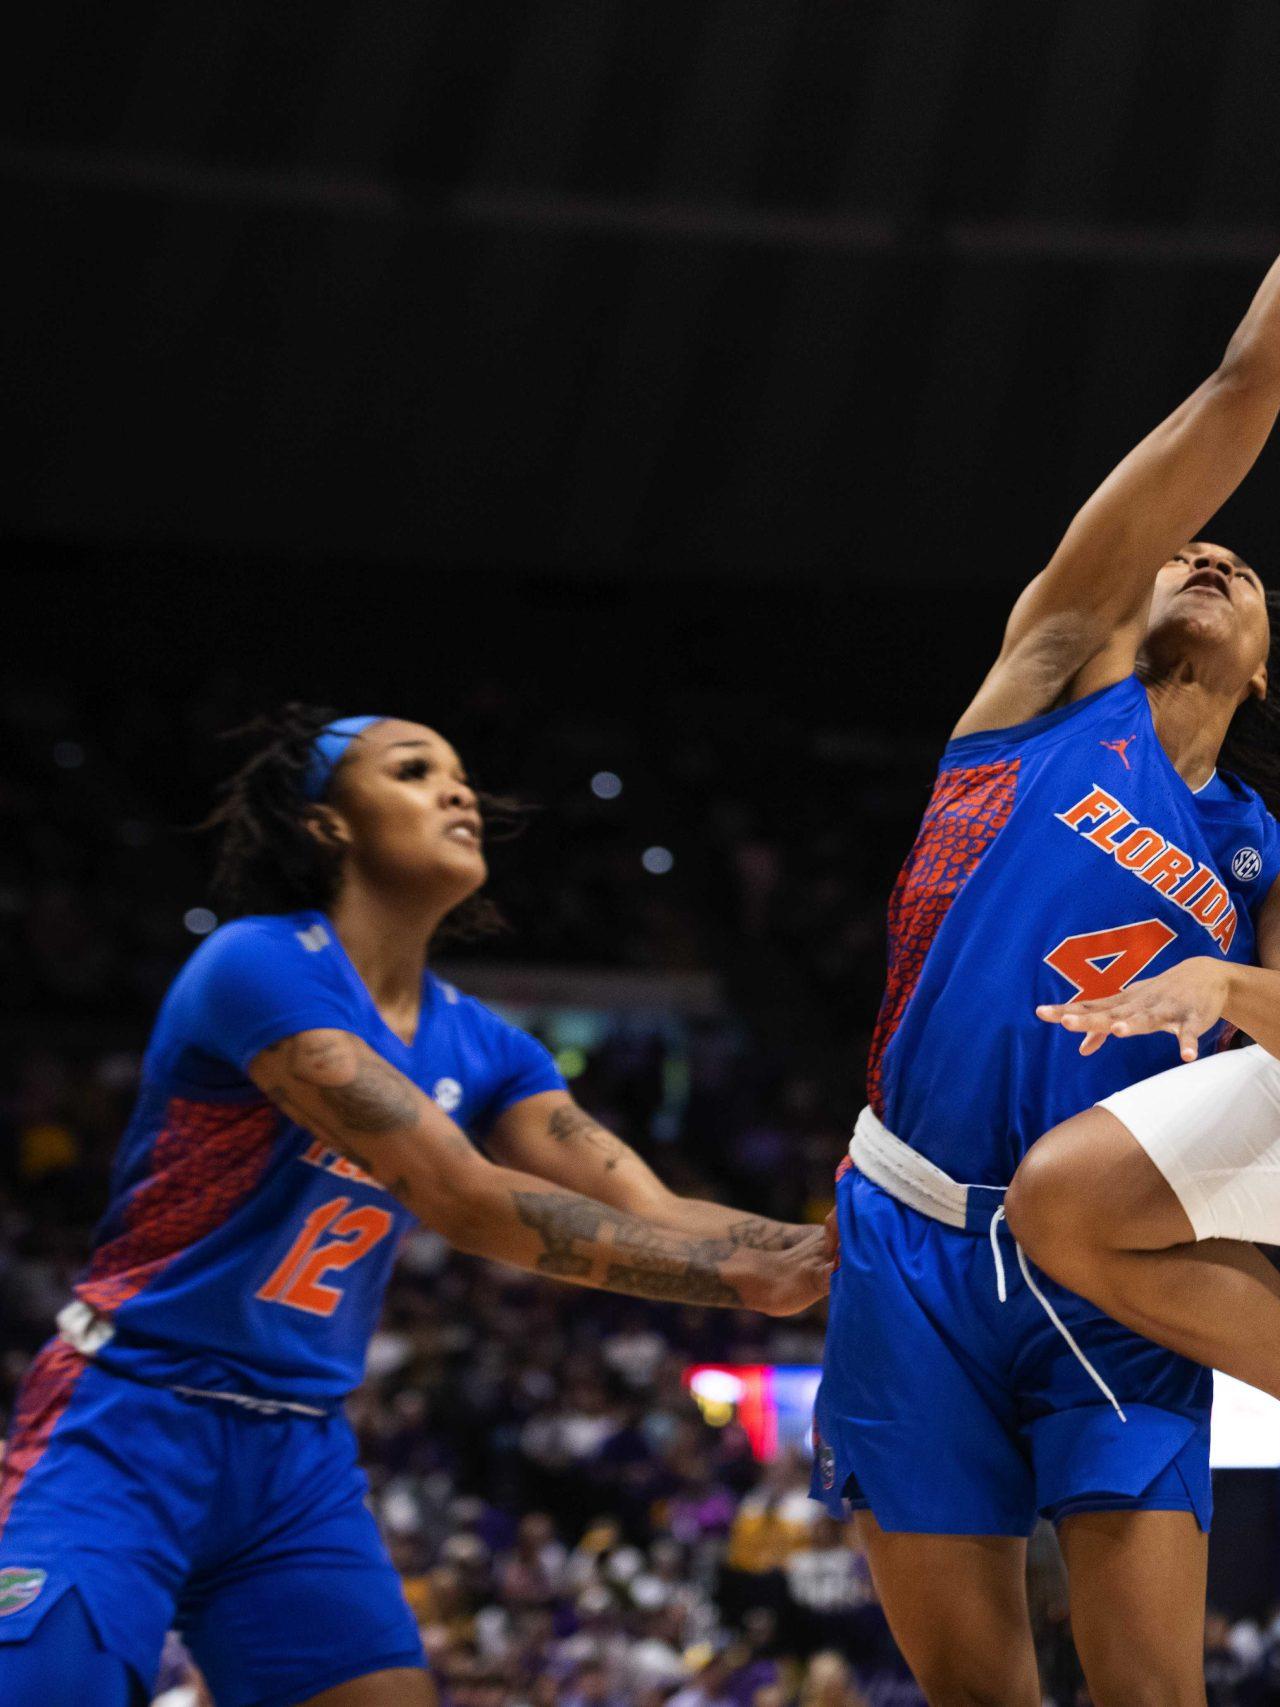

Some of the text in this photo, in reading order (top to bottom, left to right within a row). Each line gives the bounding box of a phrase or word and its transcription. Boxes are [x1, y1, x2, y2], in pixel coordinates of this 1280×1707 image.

[1054, 783, 1238, 955] FLORIDA
[1234, 849, 1260, 879] SEC
[1043, 917, 1179, 1005] 4
[255, 1196, 394, 1318] 12
